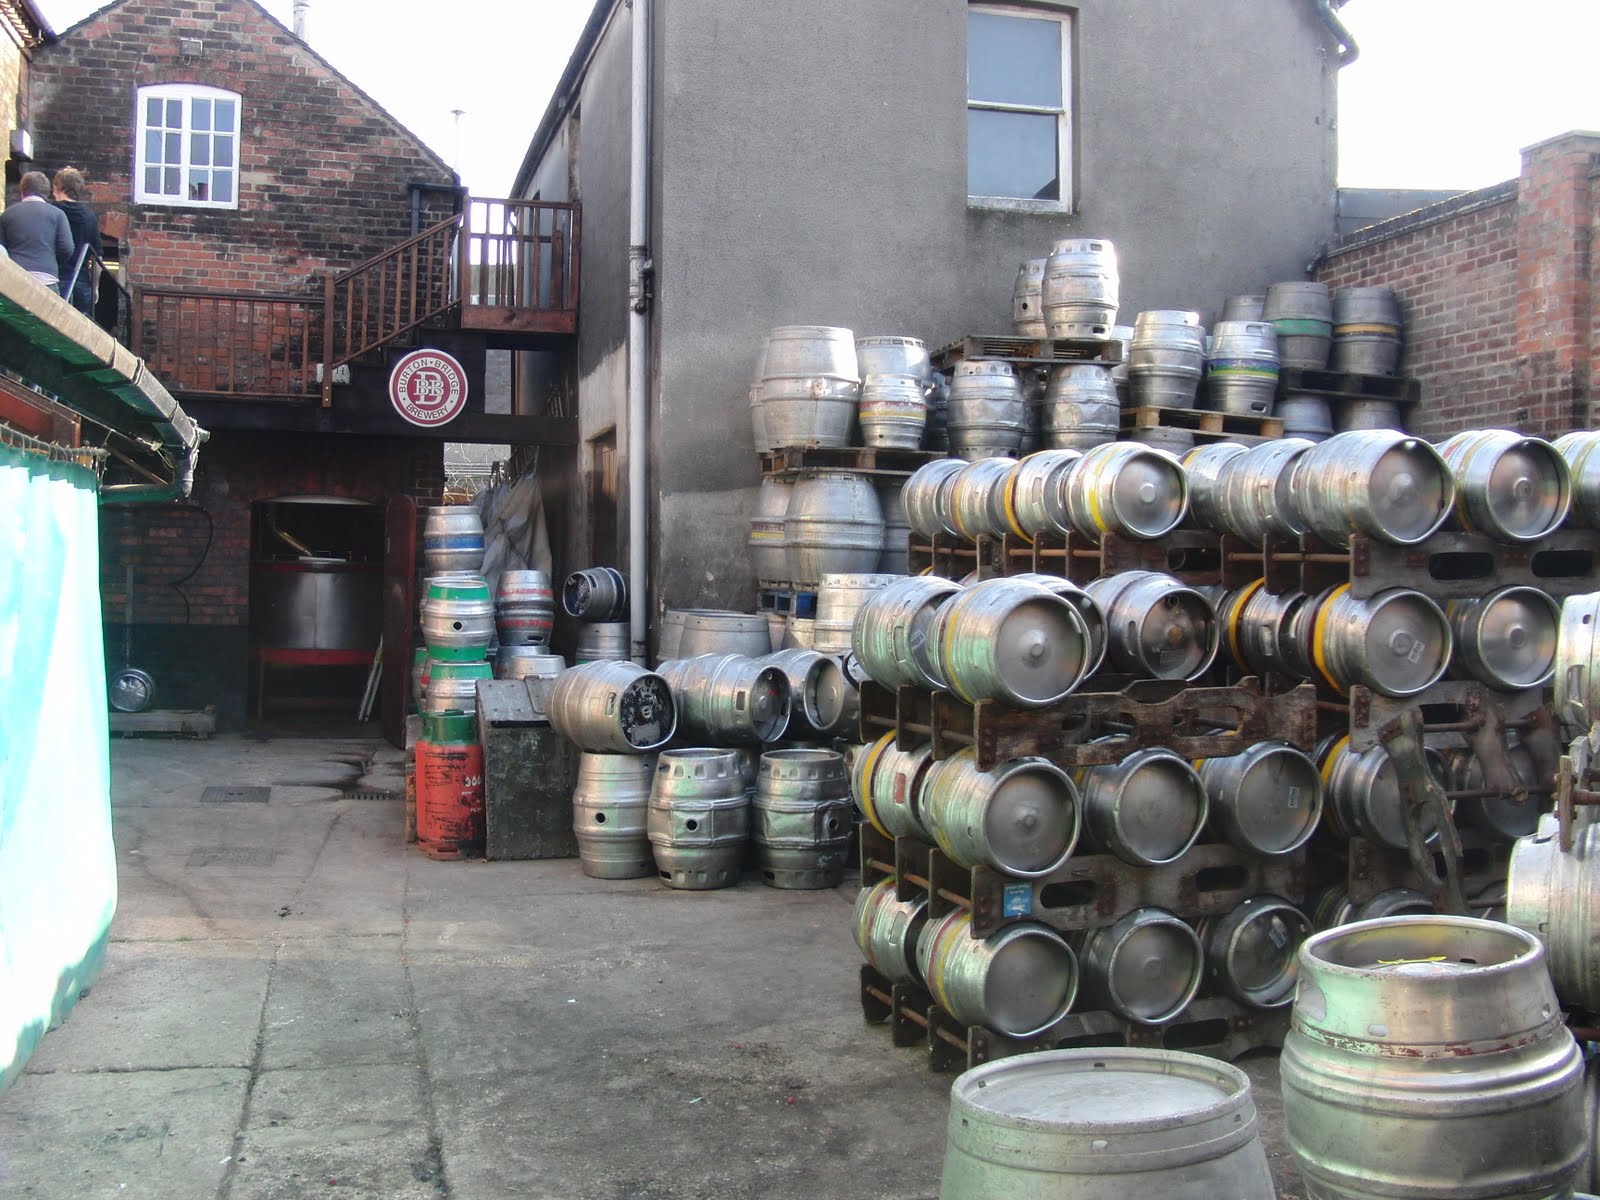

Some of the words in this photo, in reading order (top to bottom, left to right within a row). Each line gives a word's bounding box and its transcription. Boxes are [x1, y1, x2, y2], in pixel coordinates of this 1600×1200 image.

[399, 359, 428, 393] BURTON
[434, 360, 459, 395] BRIDGE
[405, 403, 449, 419] BREWERY
